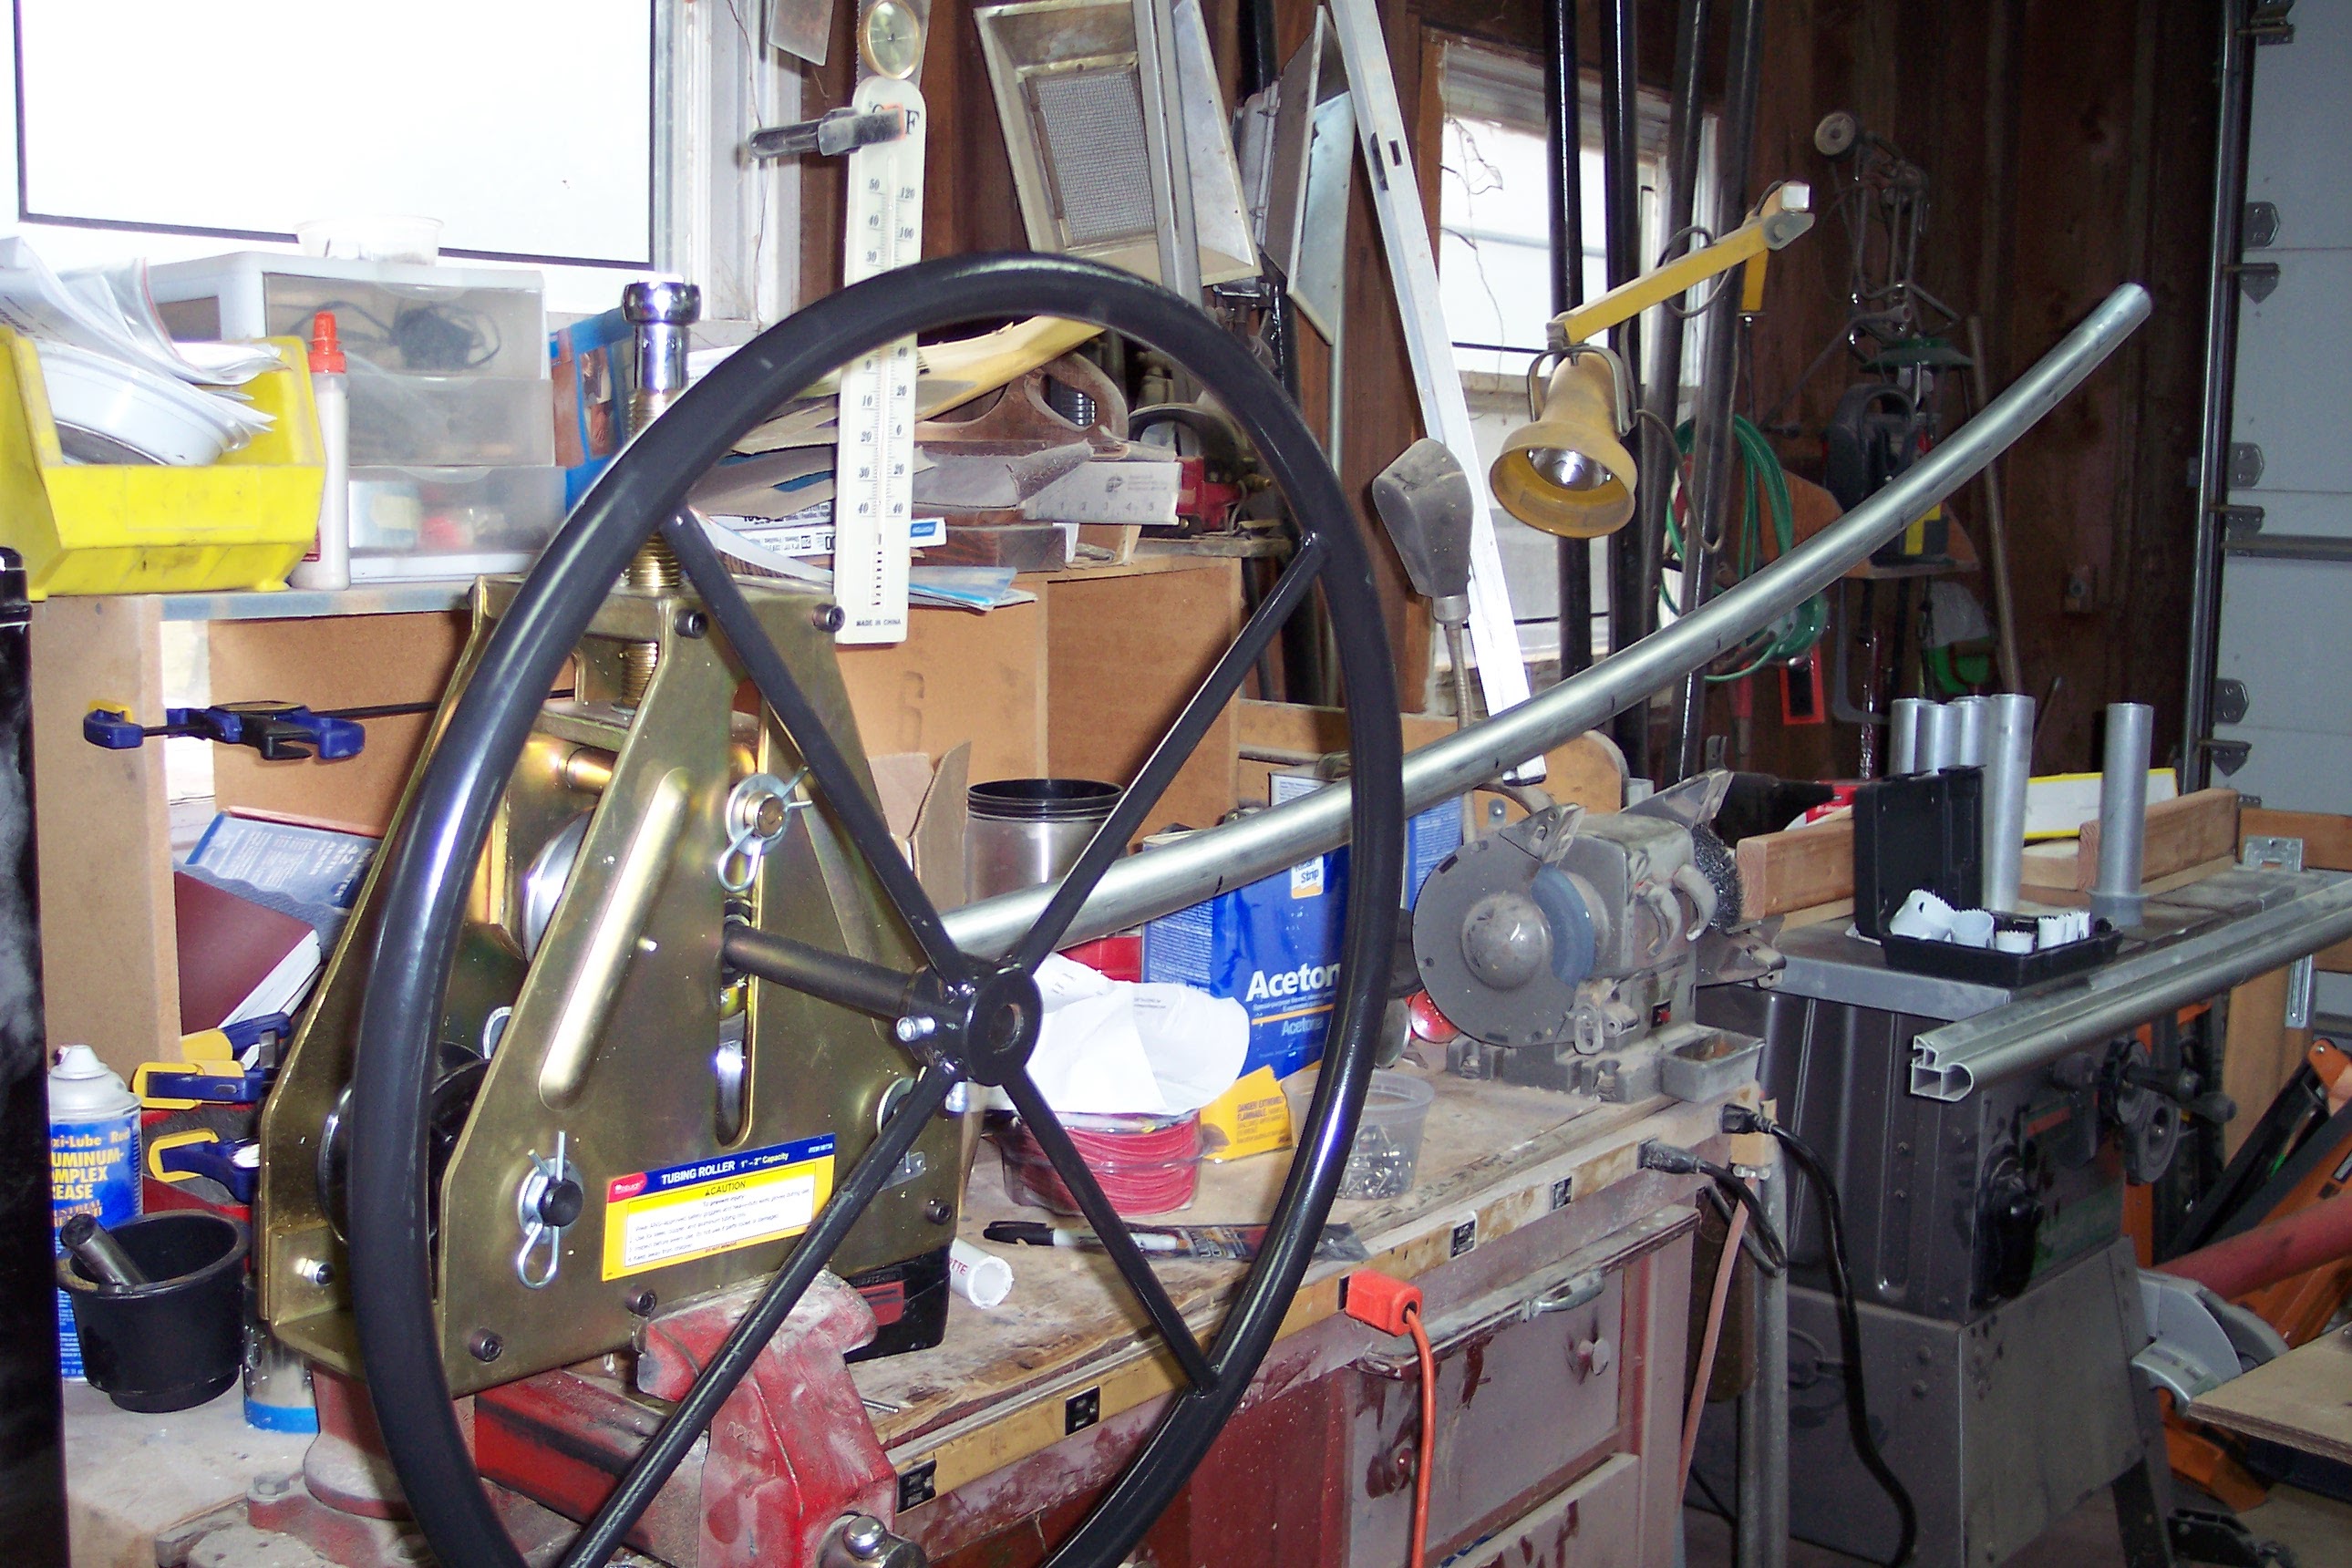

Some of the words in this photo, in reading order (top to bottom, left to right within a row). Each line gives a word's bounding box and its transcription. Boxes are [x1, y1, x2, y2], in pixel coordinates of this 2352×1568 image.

[869, 179, 881, 191] 50
[901, 187, 915, 199] 120
[868, 215, 880, 227] 40
[899, 227, 914, 239] 100
[866, 252, 877, 263] 30
[897, 346, 908, 357] 40
[896, 385, 907, 397] 20
[861, 395, 872, 407] 10
[861, 431, 872, 443] 20
[859, 467, 870, 479] 30
[893, 463, 904, 475] 20
[858, 502, 869, 514] 40
[892, 502, 903, 514] 40
[1301, 869, 1319, 883] Strip
[1245, 963, 1341, 1002] Aceton
[51, 1134, 103, 1149] xi-Lube
[51, 1148, 124, 1168] UMINUM-
[661, 1168, 696, 1185] TUBING
[698, 1161, 736, 1178] ROLLER
[762, 1151, 789, 1166] Capacity
[52, 1166, 108, 1184] MPLEX
[52, 1184, 94, 1200] EASE
[710, 1180, 746, 1195] CAUTION
[950, 1257, 969, 1276] TTE
